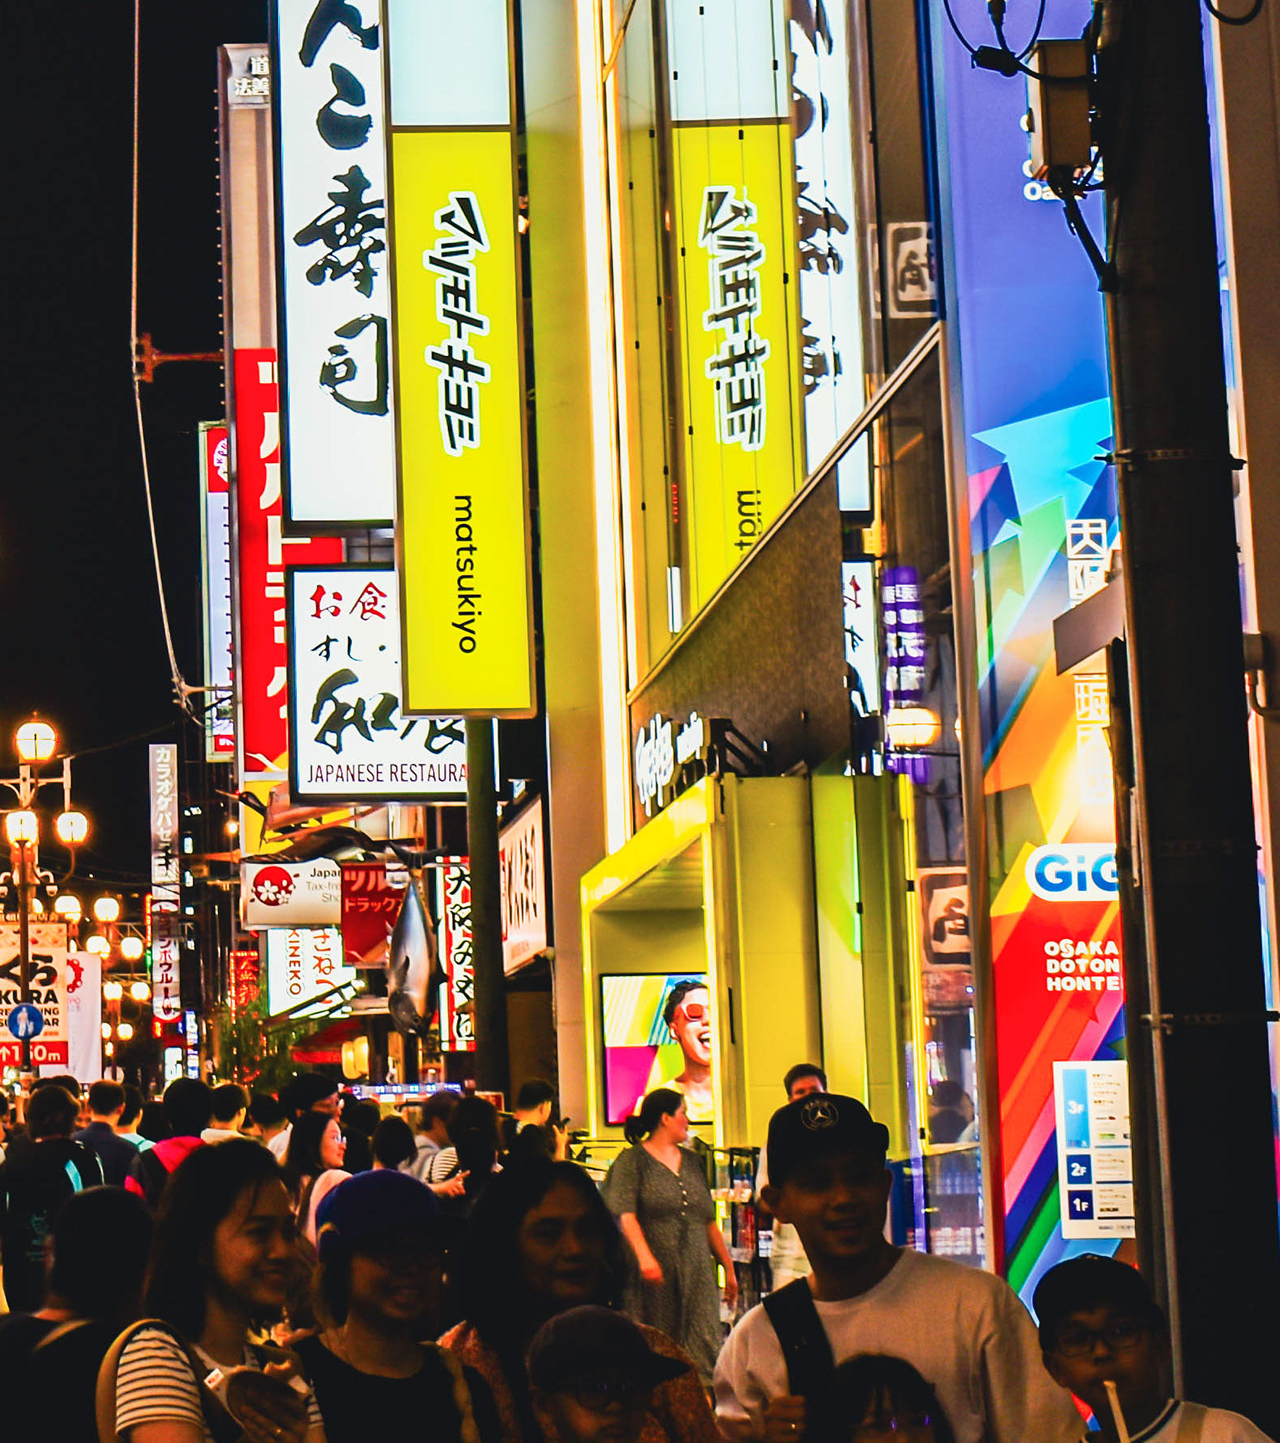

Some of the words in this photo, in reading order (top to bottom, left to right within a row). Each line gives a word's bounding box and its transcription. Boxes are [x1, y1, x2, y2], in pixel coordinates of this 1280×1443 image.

[424, 190, 490, 457] マツモトキヨシ
[452, 494, 481, 655] matsukiyo
[307, 765, 383, 784] JAPANESE
[389, 765, 467, 783] RESTAURA
[1034, 852, 1122, 893] GiG
[1044, 939, 1119, 958] OSAKA
[1046, 959, 1120, 974] DOTON
[1046, 976, 1120, 991] HONTE
[1070, 1162, 1087, 1177] 2F
[1073, 1198, 1090, 1212] 1F
